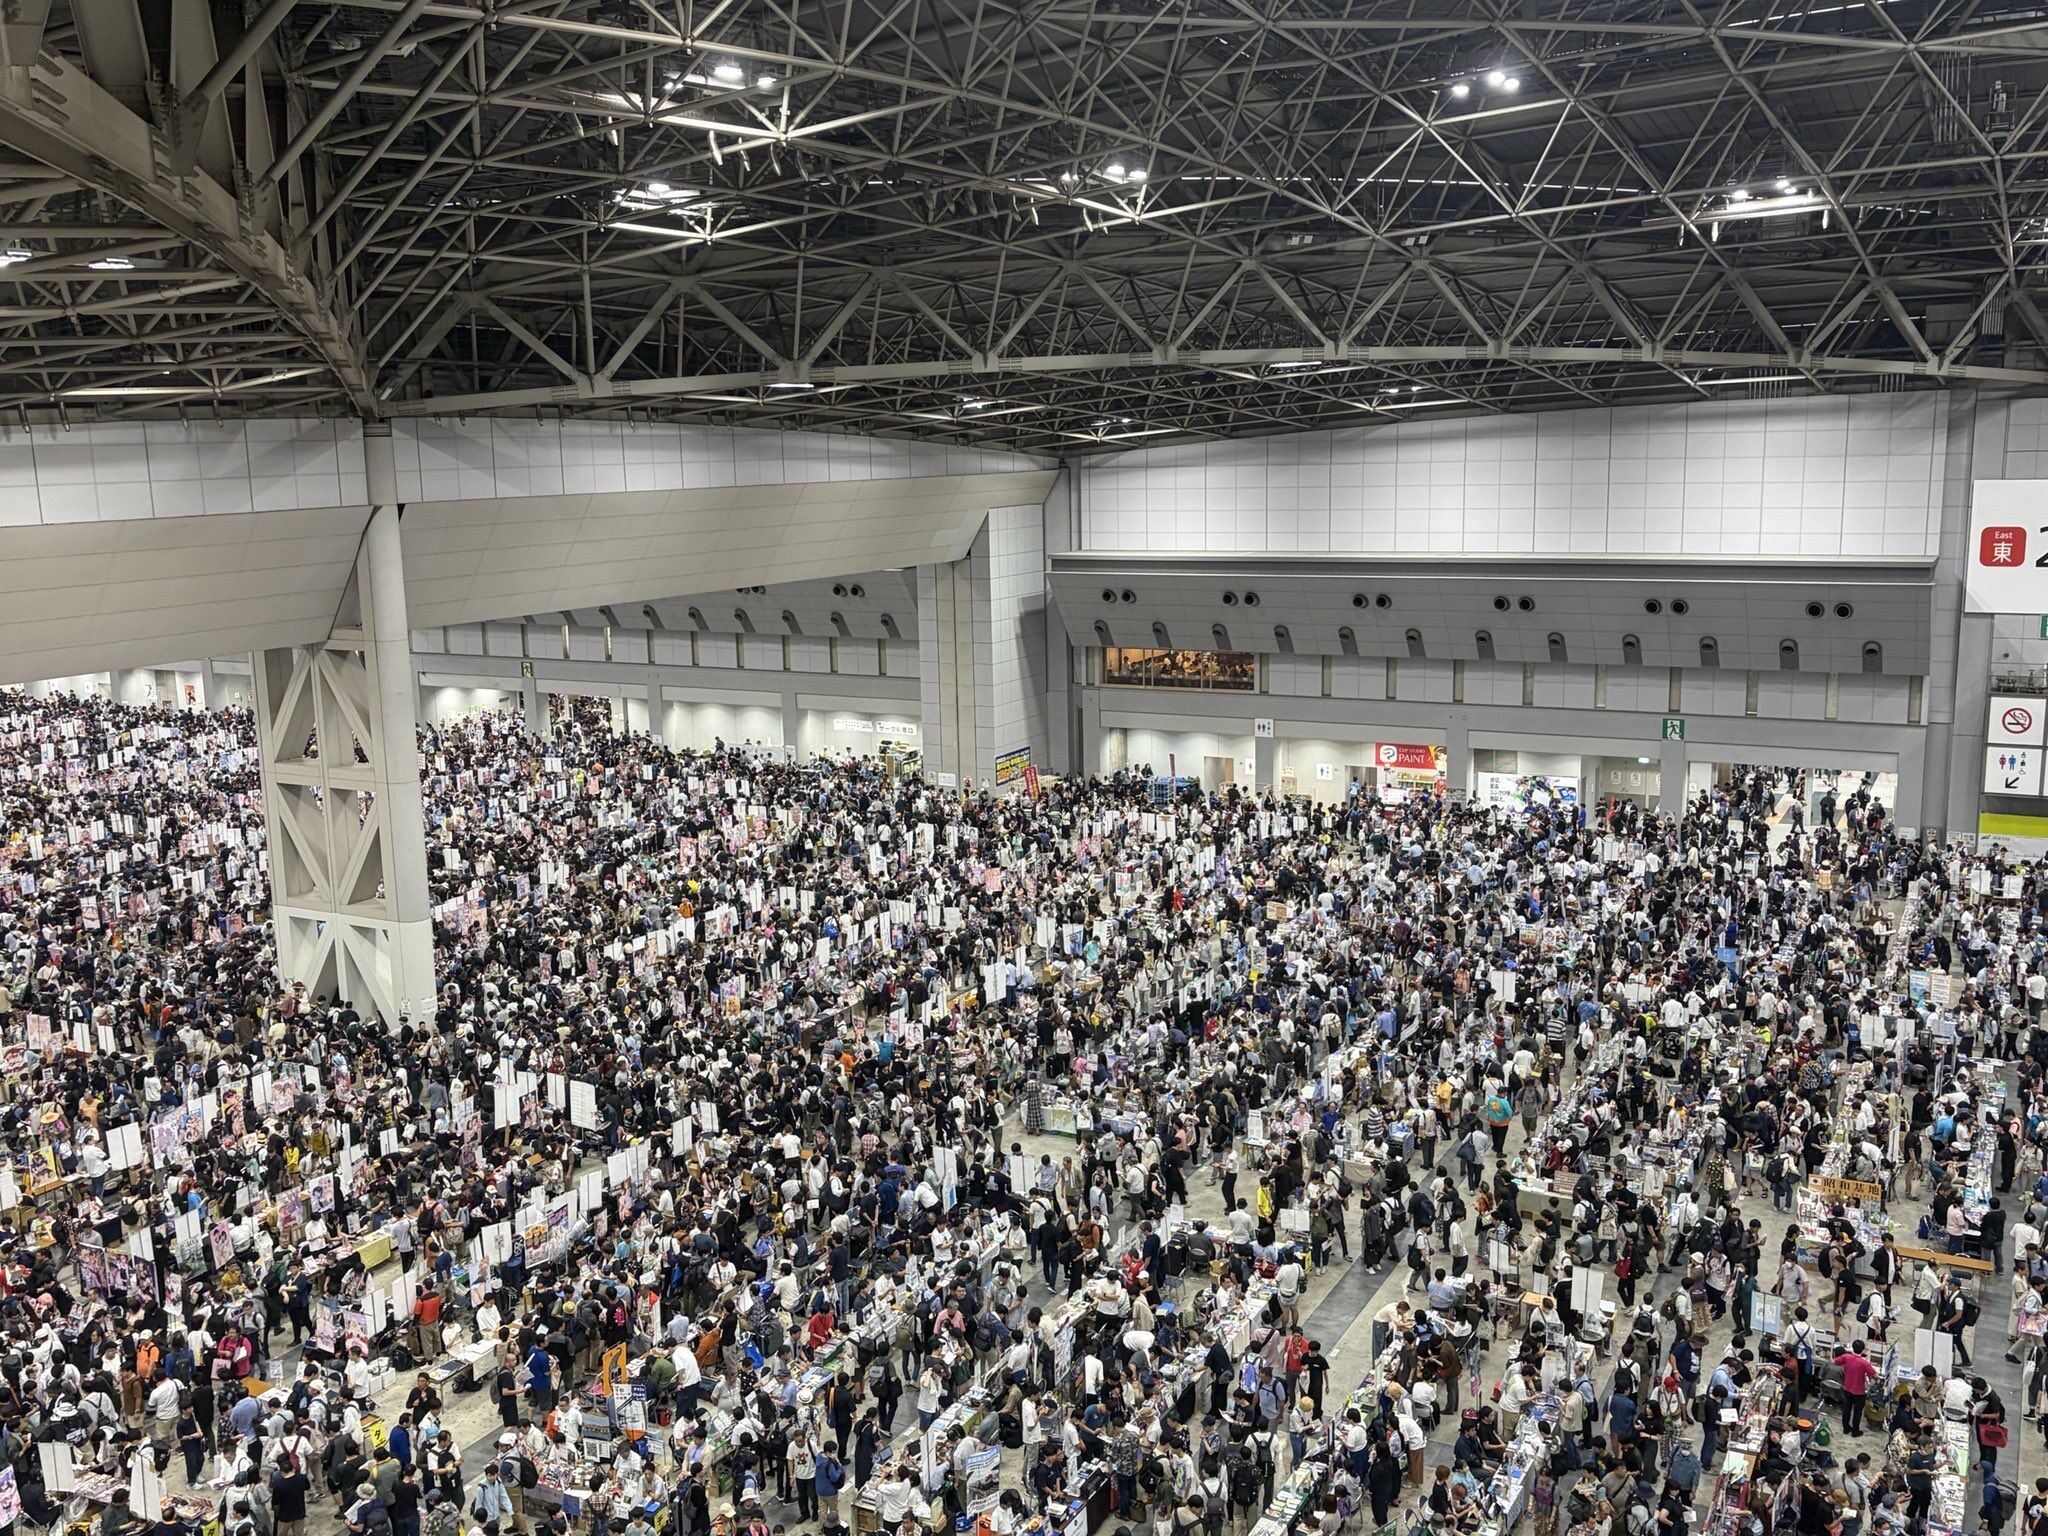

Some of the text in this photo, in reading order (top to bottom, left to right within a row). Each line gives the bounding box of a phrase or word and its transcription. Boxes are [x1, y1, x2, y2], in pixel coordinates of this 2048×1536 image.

[1994, 531, 2013, 539] East
[1992, 541, 2014, 563] 東
[1399, 754, 1425, 764] PAINT
[1822, 1178, 1880, 1196] 昭和基地
